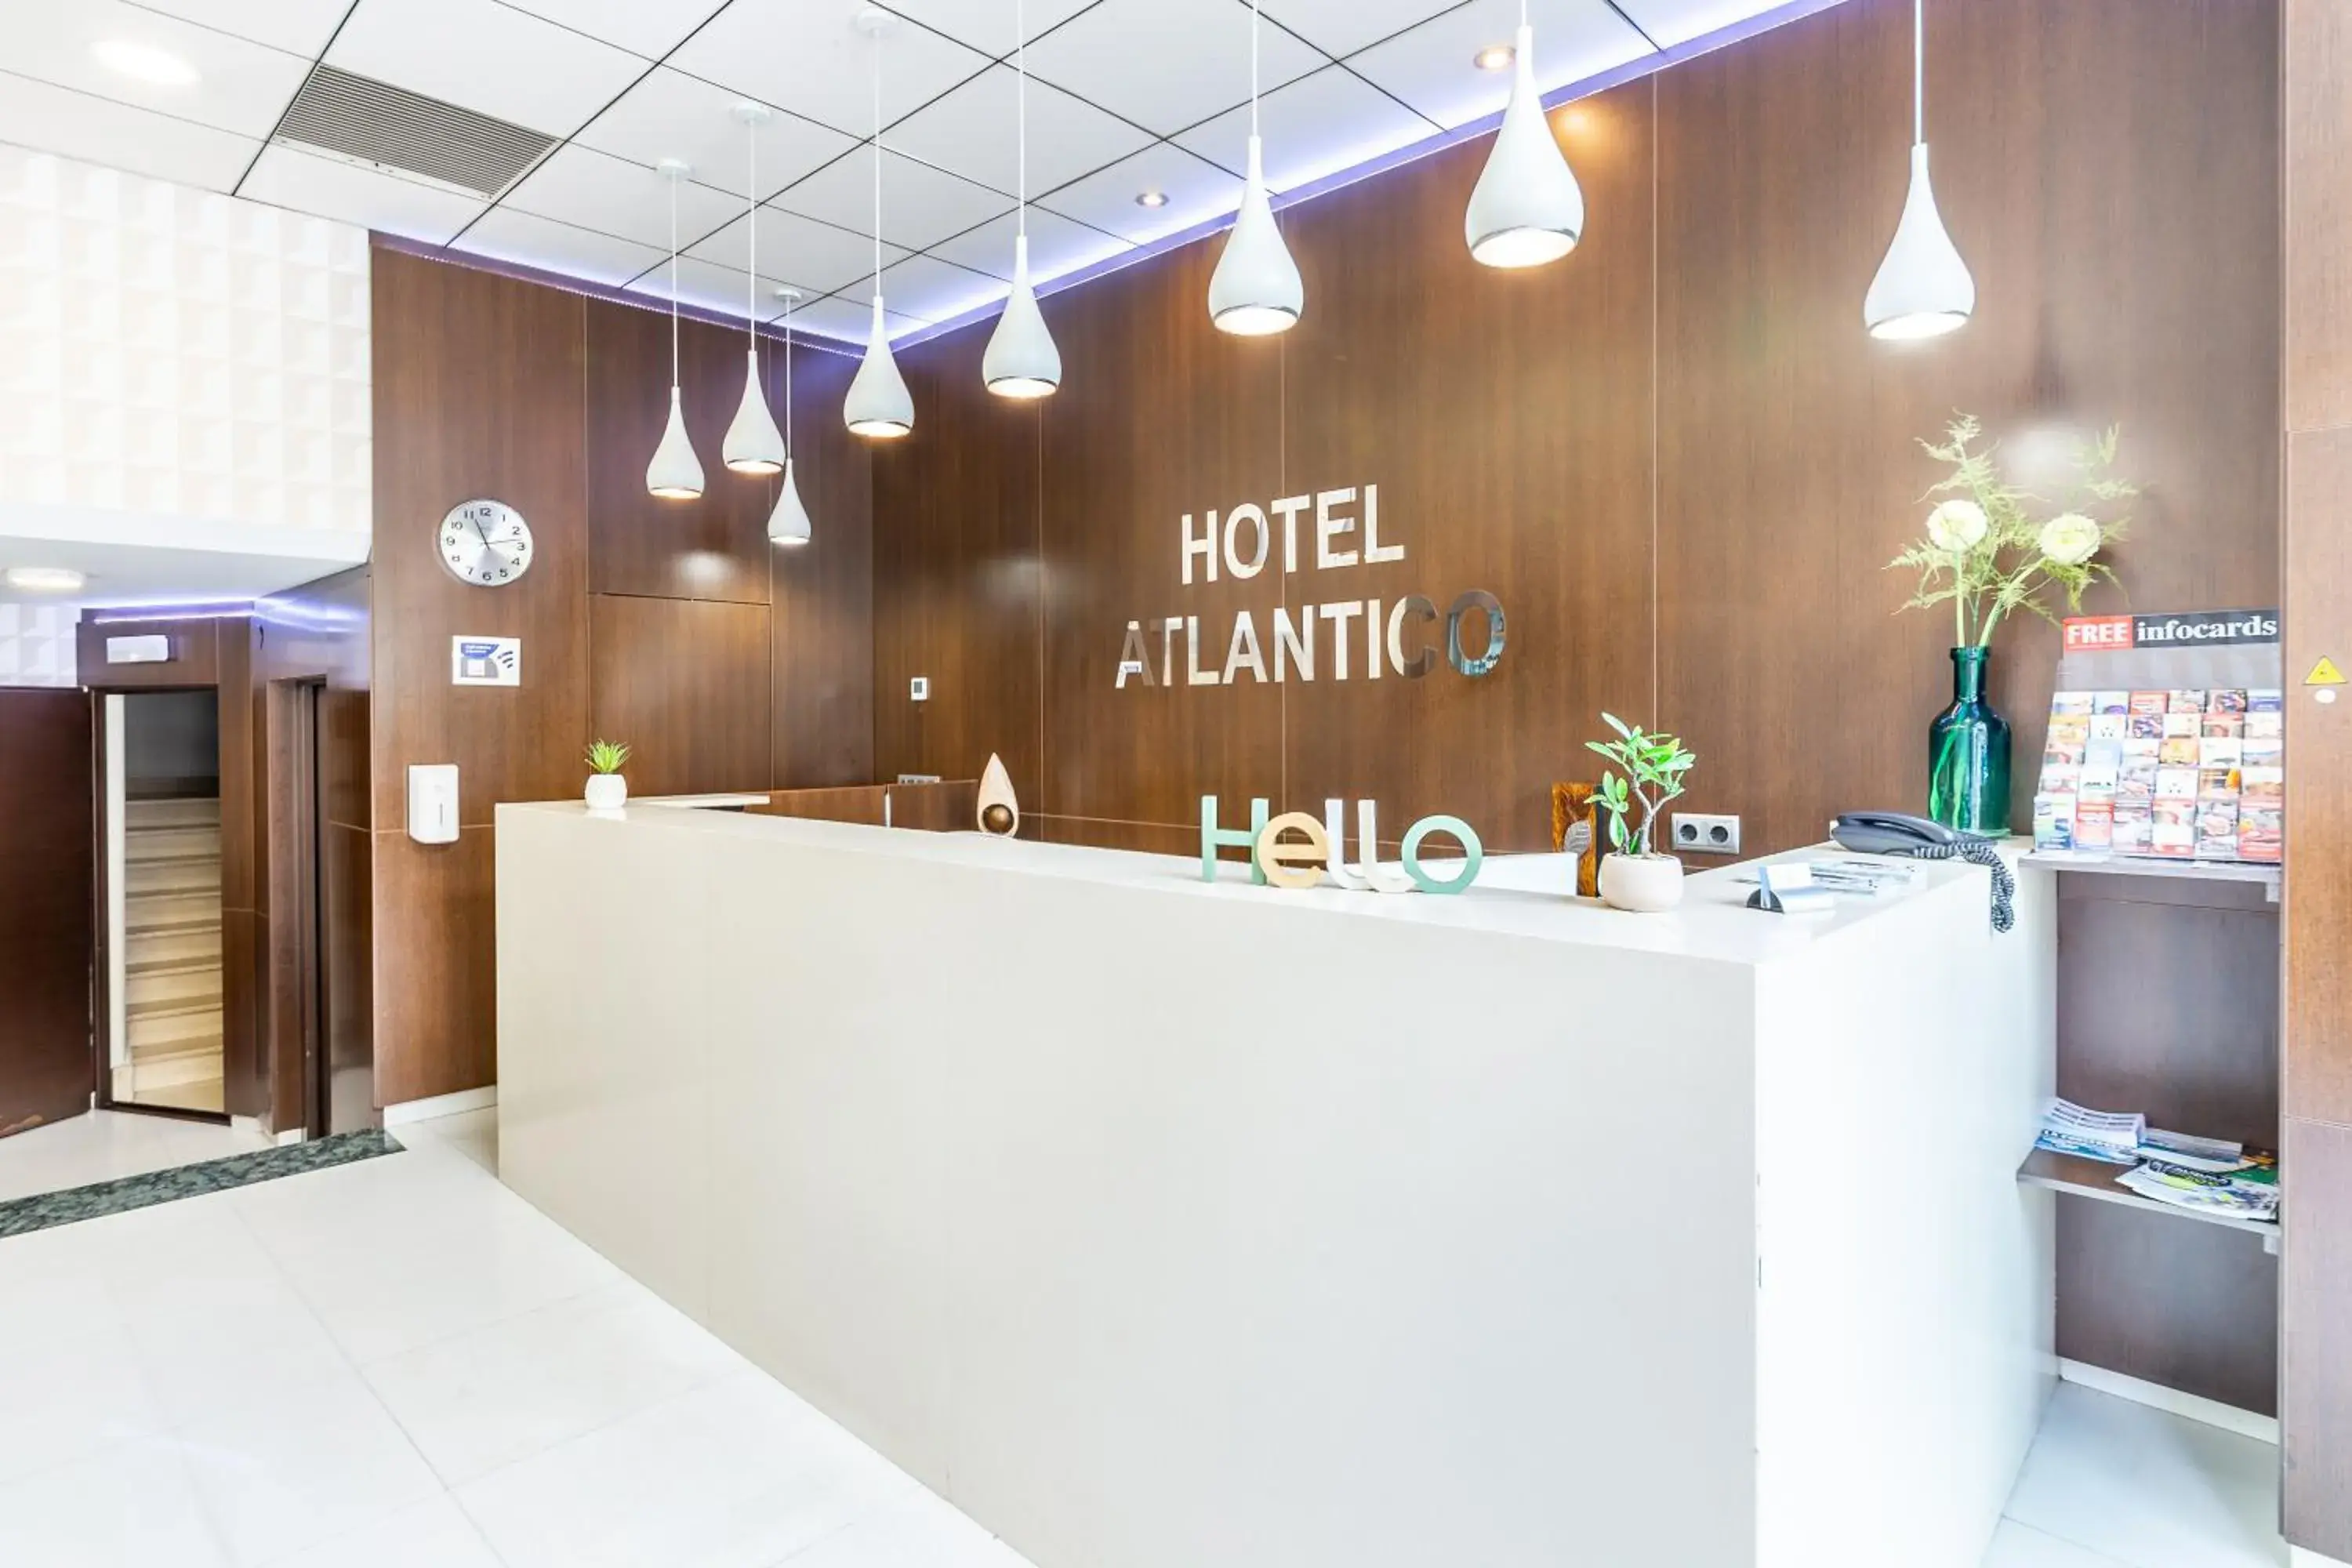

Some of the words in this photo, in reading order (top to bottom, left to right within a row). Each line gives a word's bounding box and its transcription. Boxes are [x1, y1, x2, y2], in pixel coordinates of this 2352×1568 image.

[464, 510, 474, 519] 11
[451, 521, 463, 530] 10
[512, 526, 521, 535] 2
[1181, 484, 1404, 585] HOTEL
[446, 536, 455, 546] 9
[467, 566, 474, 575] 7
[499, 568, 508, 577] 5
[482, 572, 492, 580] 6
[2067, 622, 2129, 644] FREE
[2137, 615, 2278, 642] infocards
[1116, 589, 1507, 689] ATLANTICO
[1201, 795, 1483, 895] Hello
